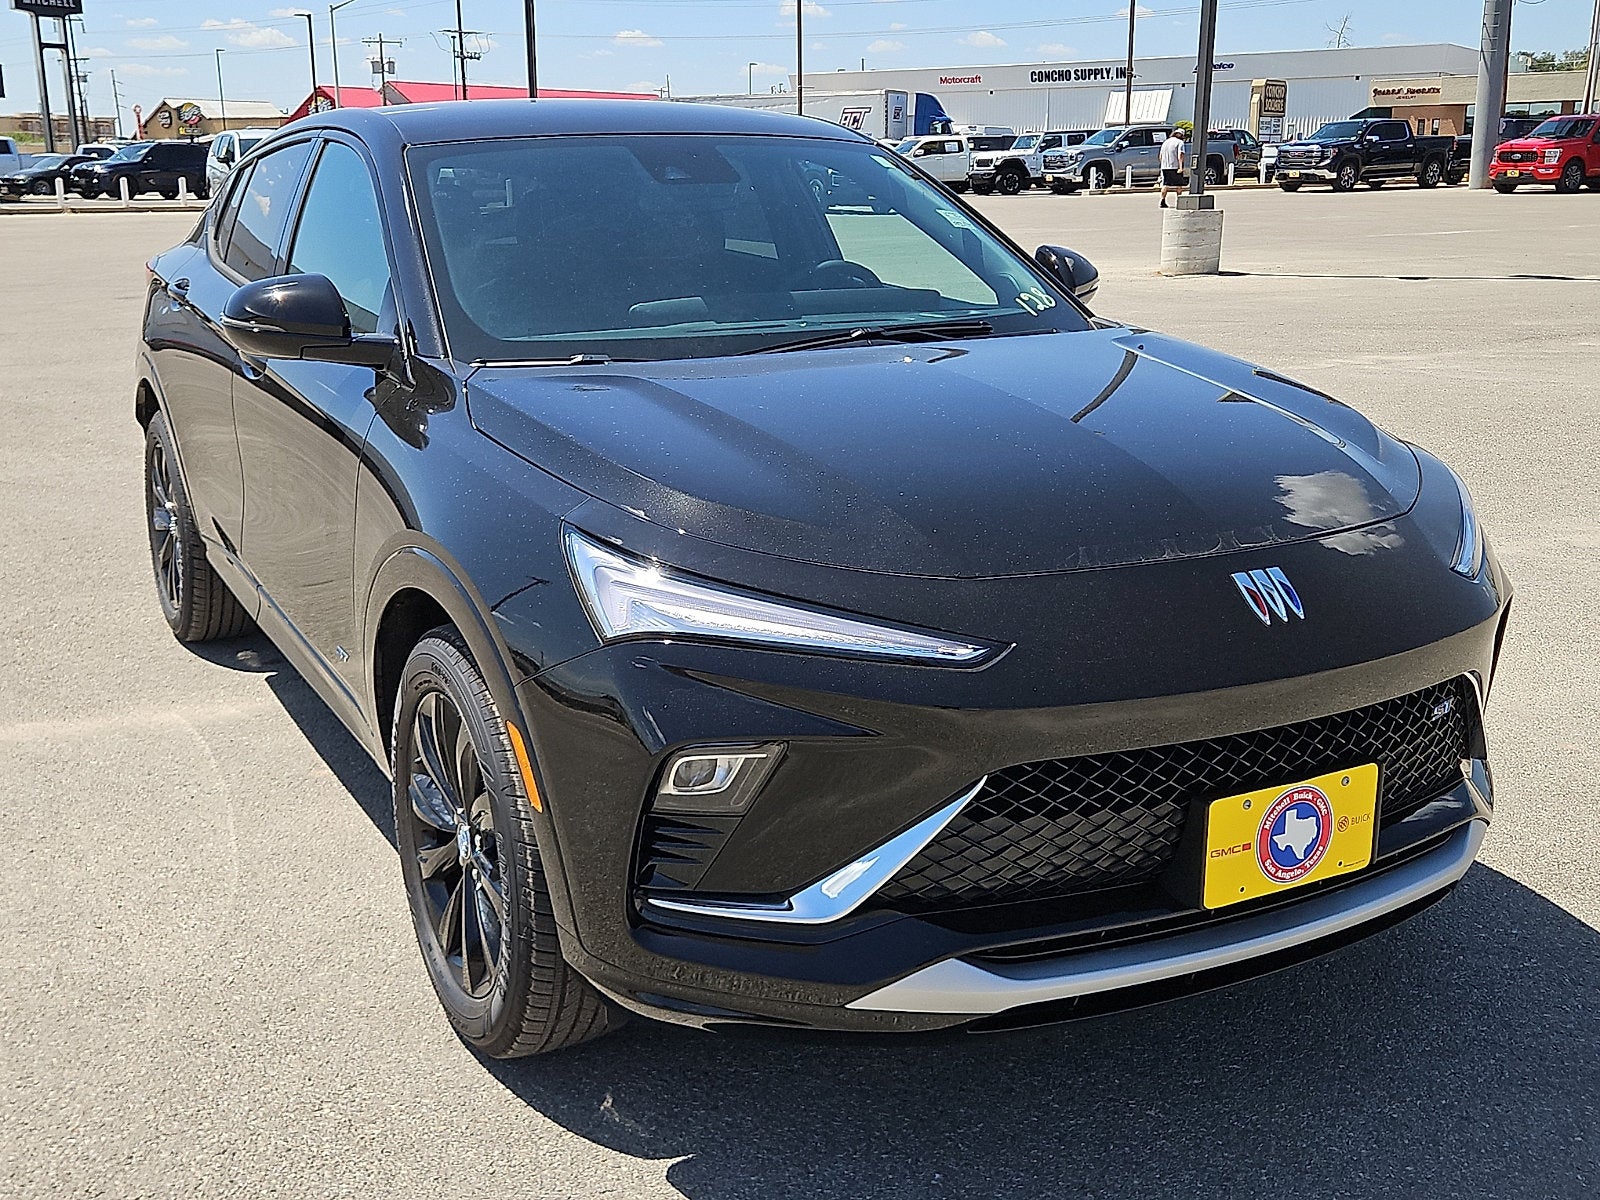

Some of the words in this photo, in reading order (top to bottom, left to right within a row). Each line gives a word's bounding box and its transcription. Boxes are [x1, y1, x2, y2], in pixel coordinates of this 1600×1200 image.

[940, 75, 981, 84] Motorcraft
[1030, 70, 1071, 82] CONCHO
[1074, 68, 1114, 80] SUPPLY,
[1116, 67, 1136, 79] IN.
[1265, 85, 1285, 98] CONCHO
[1265, 99, 1284, 111] SQUARE
[1015, 286, 1056, 316] 128
[1264, 797, 1290, 830] Mitchell
[1293, 792, 1313, 801] Buick
[1317, 798, 1328, 816] GMC
[1351, 813, 1370, 825] BUICK
[1211, 844, 1241, 858] GMC
[1265, 858, 1276, 874] San
[1275, 868, 1304, 879] Angelo,
[1305, 846, 1323, 868] Texas
